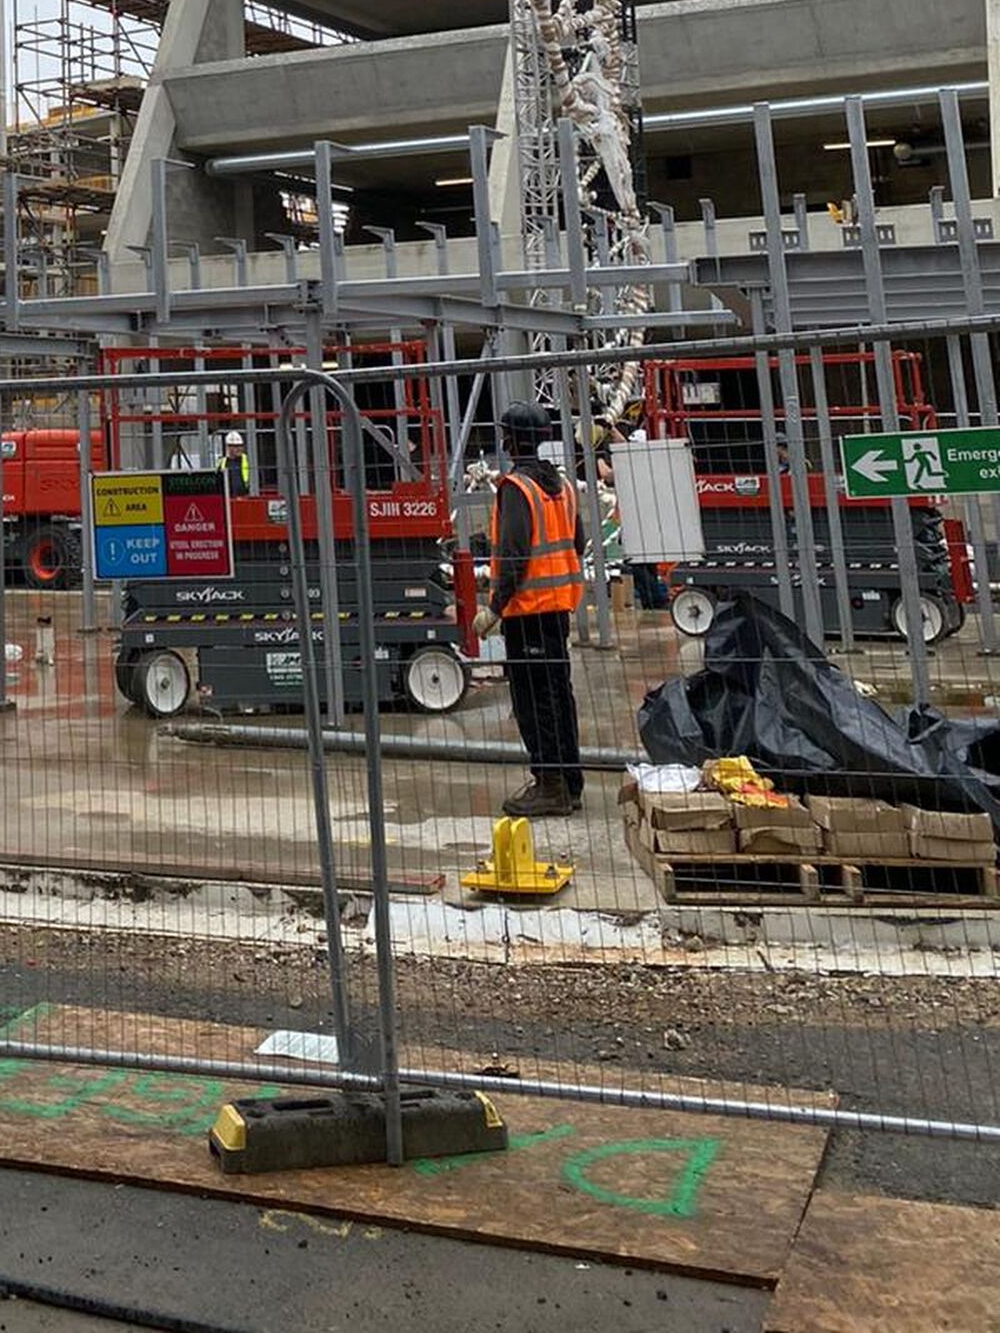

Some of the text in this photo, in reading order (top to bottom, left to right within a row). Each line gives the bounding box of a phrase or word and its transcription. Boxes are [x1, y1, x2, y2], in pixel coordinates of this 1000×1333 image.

[947, 448, 1000, 462] Emerg
[96, 486, 160, 496] CONSTRUCTION
[125, 503, 147, 512] AREA
[403, 502, 437, 516] 3226
[174, 522, 216, 532] DANGER
[126, 537, 160, 549] KEEP
[717, 542, 772, 554] SKYJACK
[130, 552, 158, 564] OUT
[176, 587, 245, 602] SKYJACK
[254, 627, 324, 643] SKYJAK
